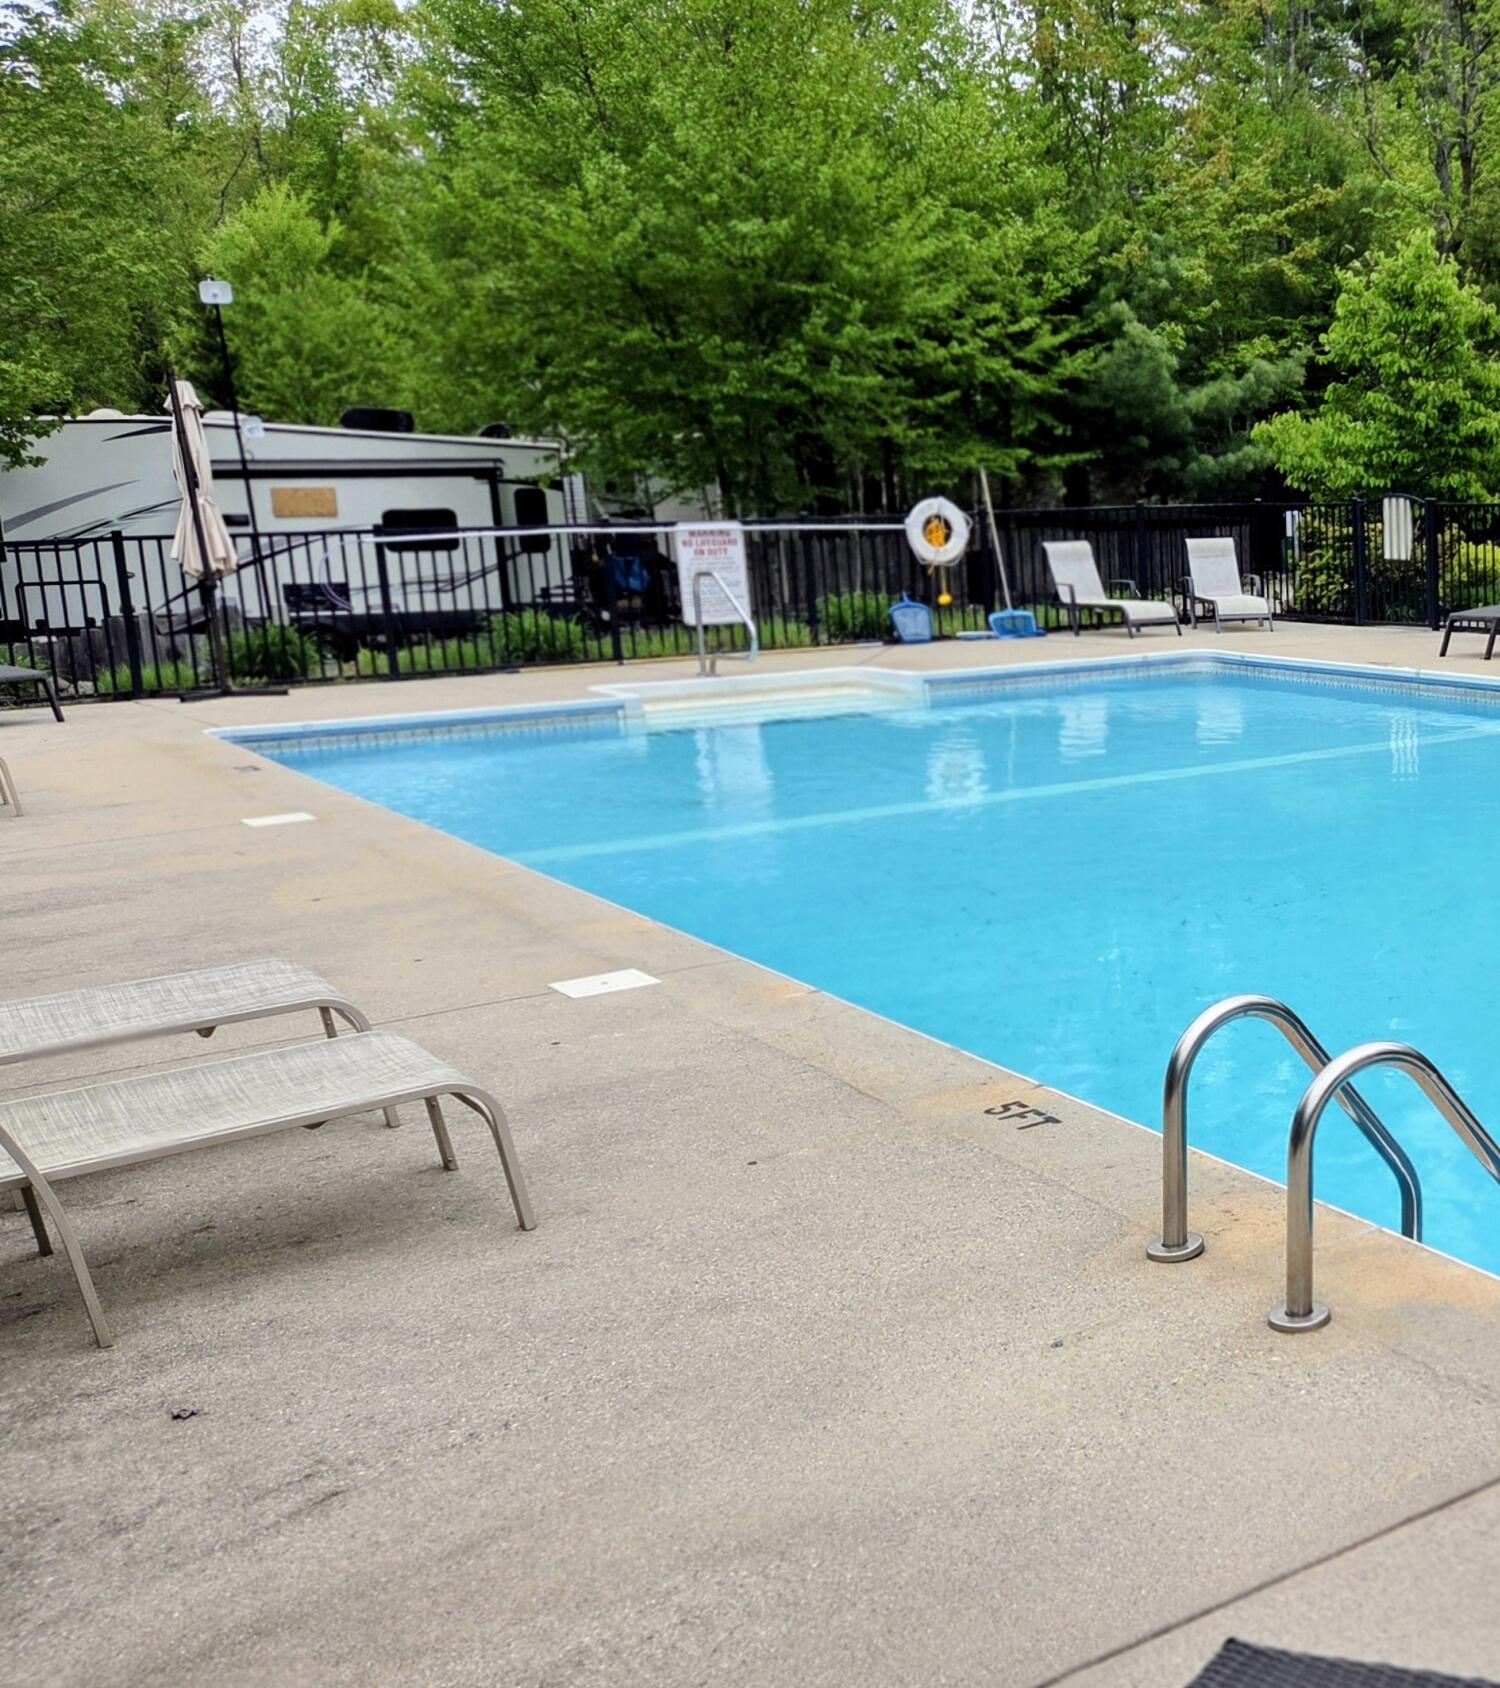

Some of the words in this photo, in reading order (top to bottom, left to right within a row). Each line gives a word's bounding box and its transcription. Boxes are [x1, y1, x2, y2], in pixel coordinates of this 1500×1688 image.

[682, 539, 693, 547] NO
[696, 538, 737, 547] LIFEGUARD
[694, 548, 705, 556] ON
[707, 547, 728, 556] DUTY
[984, 1101, 1062, 1130] 5FT
